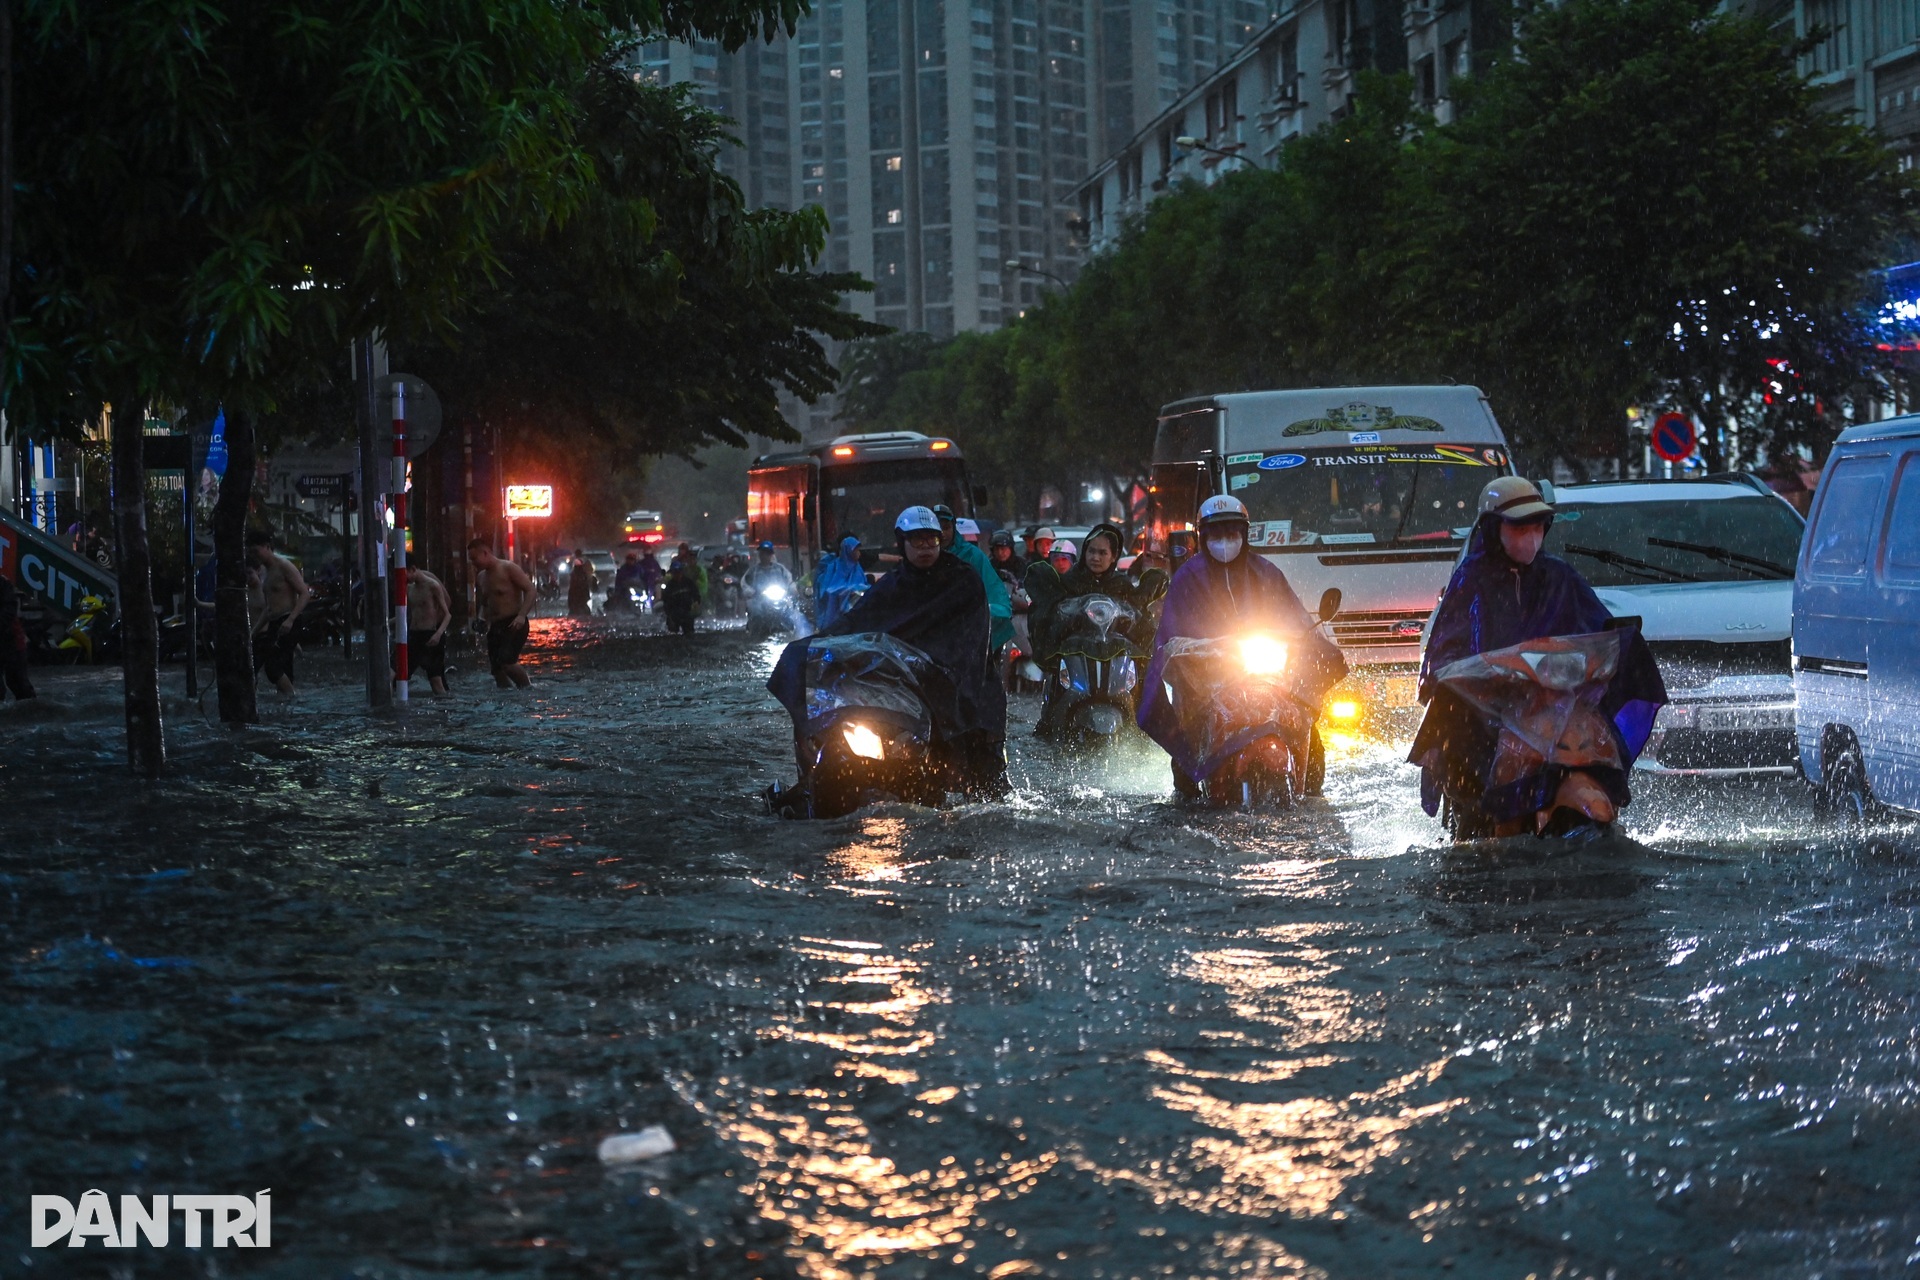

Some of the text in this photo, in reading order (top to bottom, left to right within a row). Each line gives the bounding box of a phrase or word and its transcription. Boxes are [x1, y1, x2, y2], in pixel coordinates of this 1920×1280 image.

[1268, 456, 1296, 467] Ford
[1312, 454, 1386, 467] TRANSIT
[1266, 530, 1286, 545] 24
